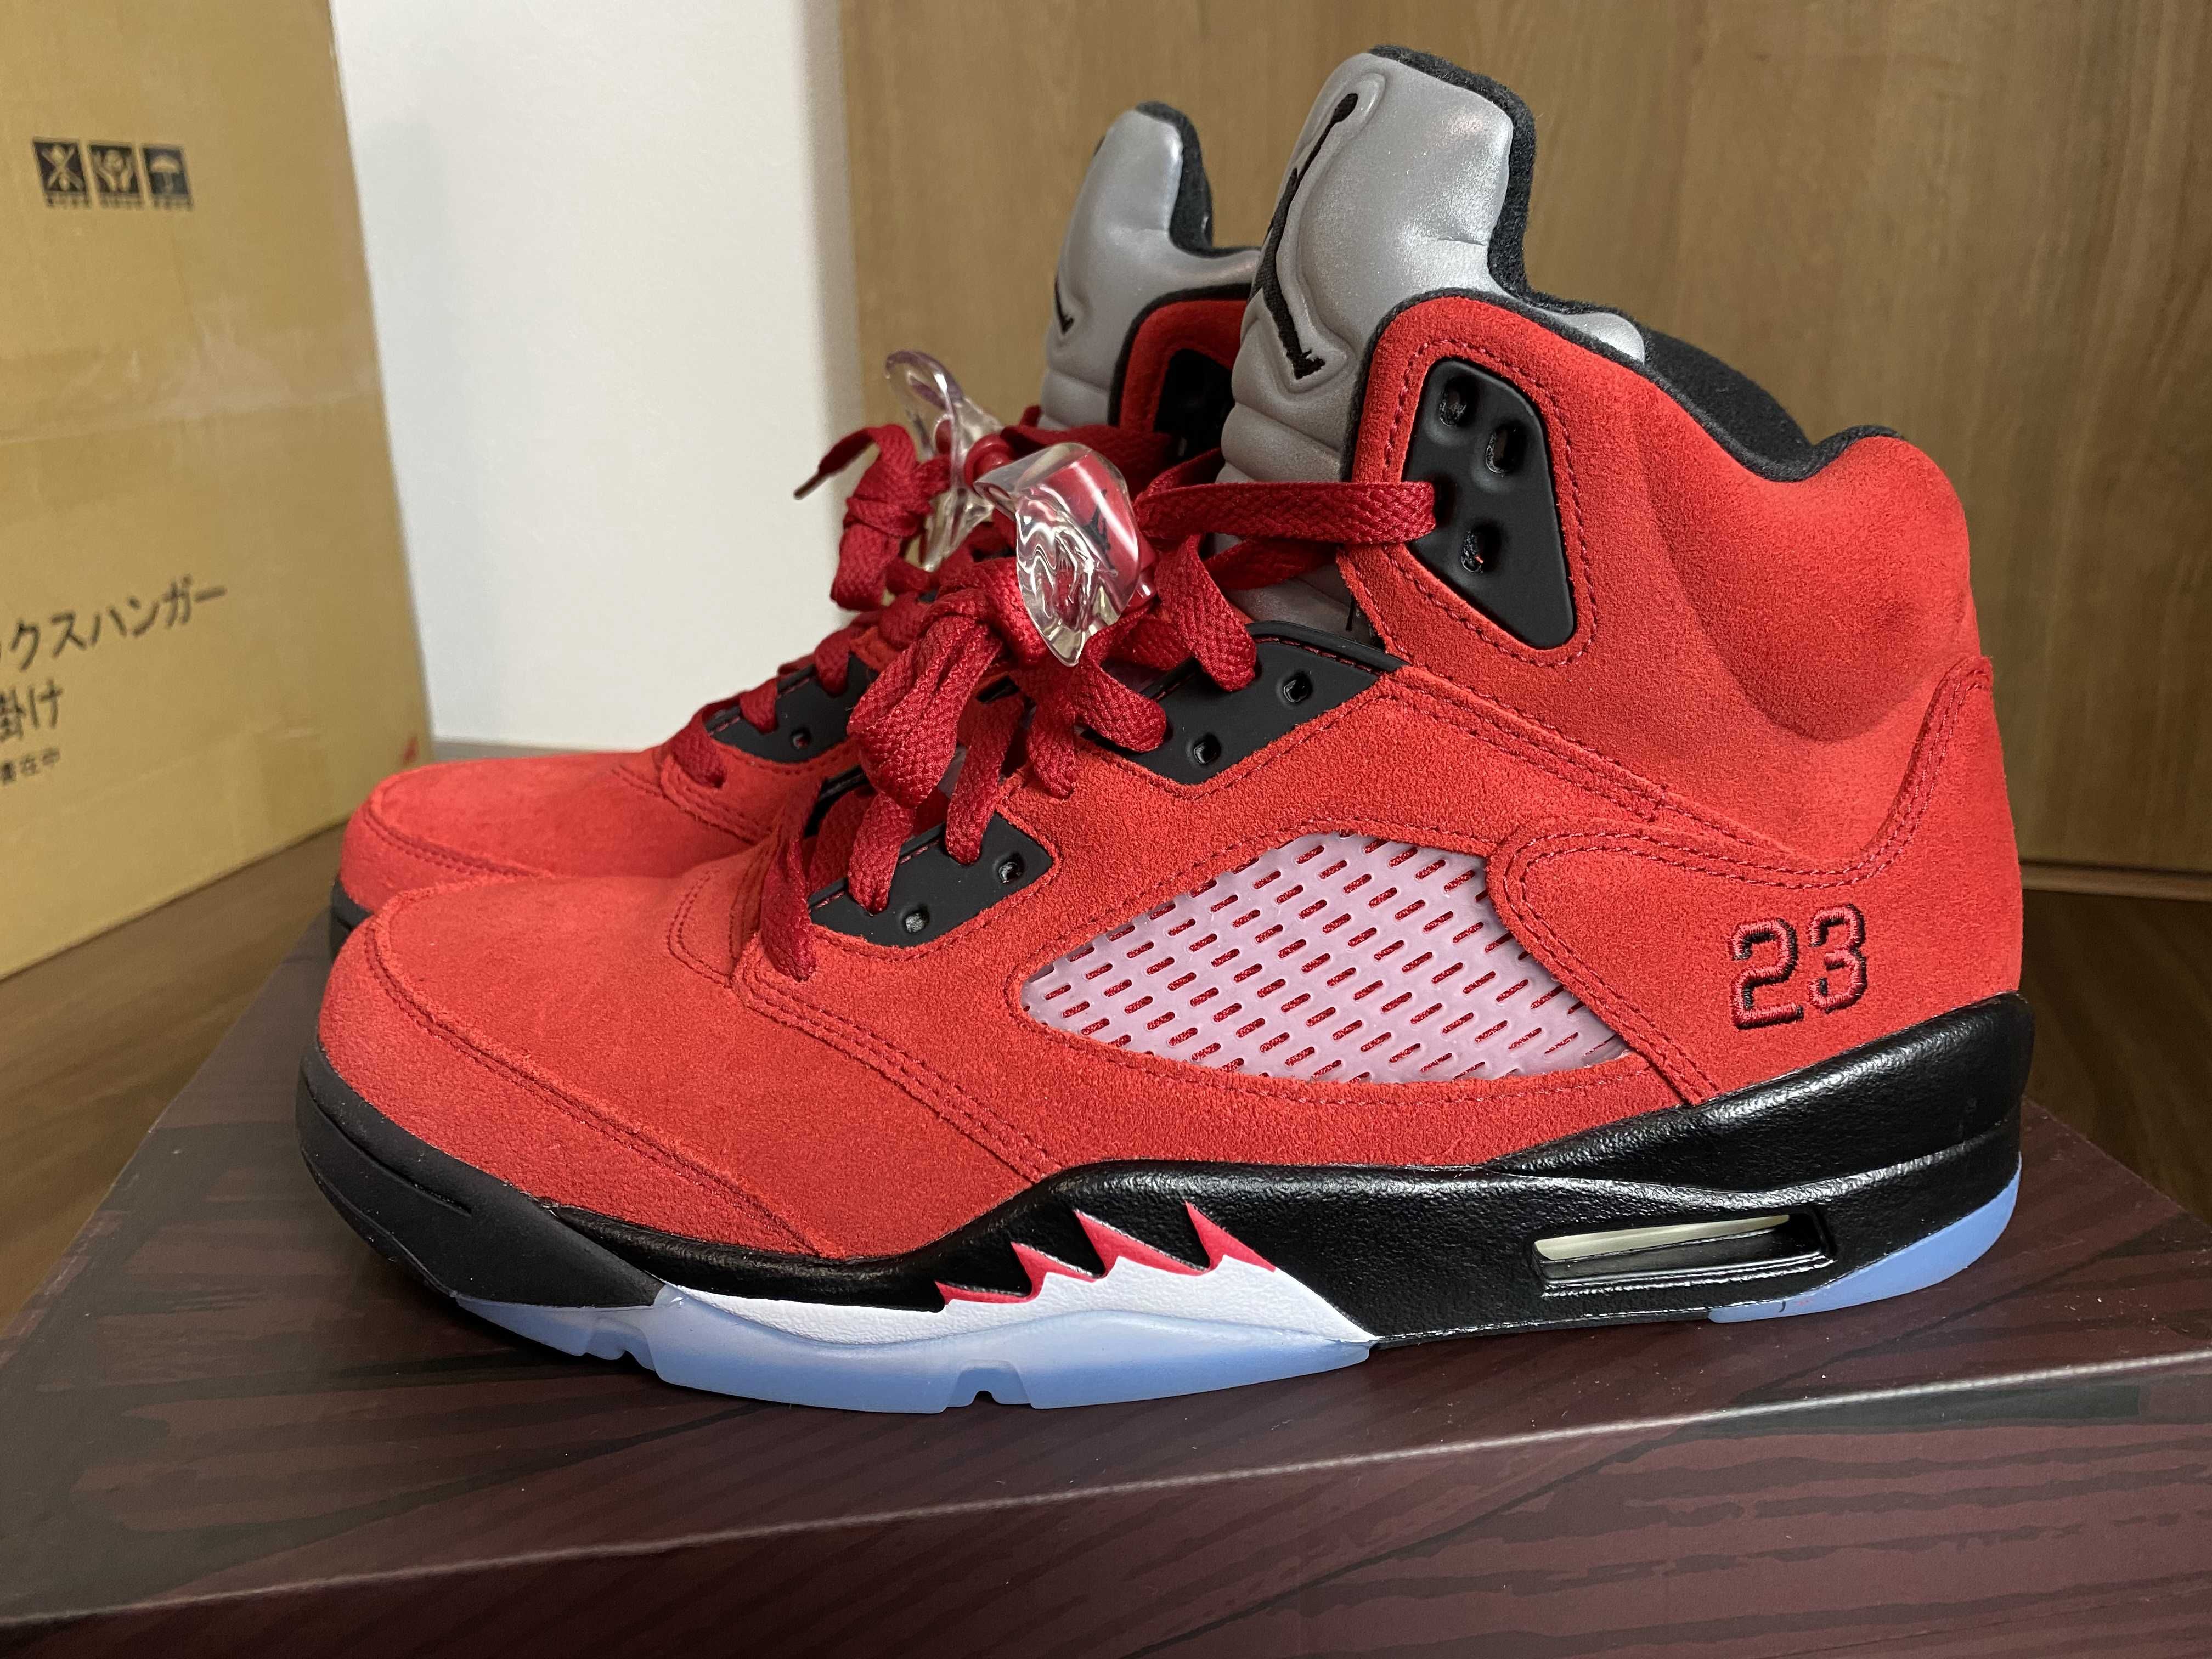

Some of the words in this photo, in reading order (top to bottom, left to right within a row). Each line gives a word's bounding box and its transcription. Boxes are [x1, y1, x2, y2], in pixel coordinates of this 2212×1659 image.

[0, 573, 227, 671] クスハンガー
[1730, 904, 1867, 1030] 23
